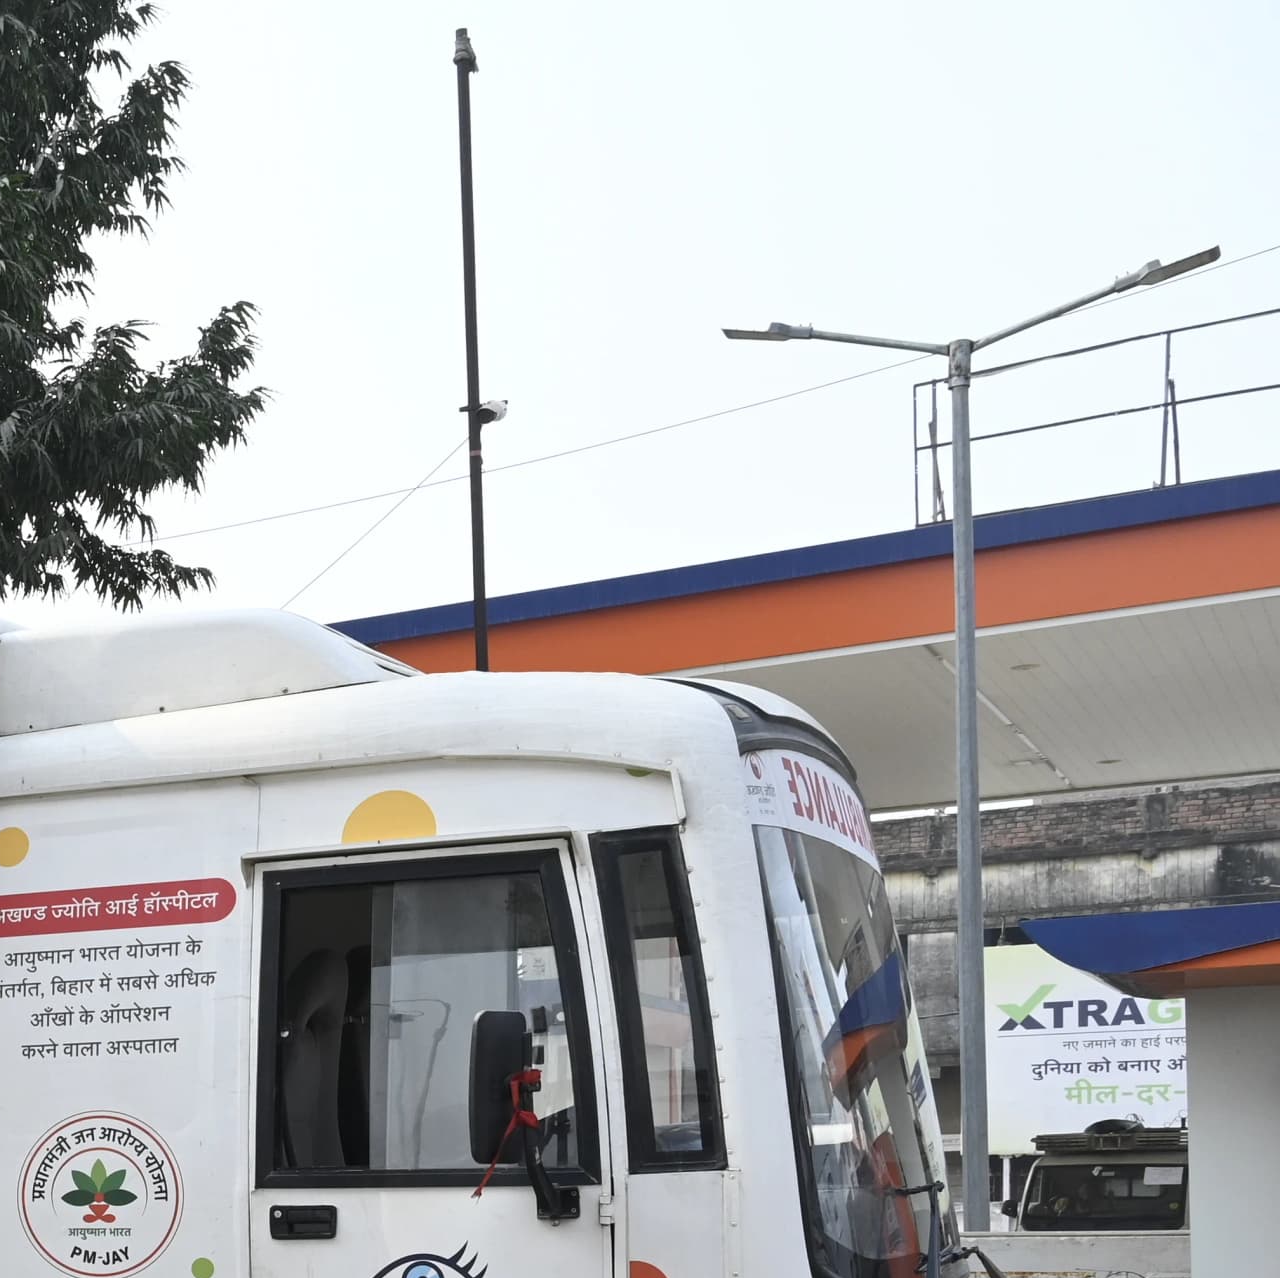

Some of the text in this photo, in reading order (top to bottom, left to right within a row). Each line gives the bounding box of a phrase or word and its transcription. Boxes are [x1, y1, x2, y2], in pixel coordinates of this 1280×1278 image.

[51, 897, 101, 919] ज्योति
[105, 893, 139, 917] आई
[143, 889, 220, 914] हॉस्पीटल
[4, 935, 203, 973] आयुष्मान भारत योजना के
[51, 975, 95, 996] बिहार
[99, 972, 114, 993] में
[117, 969, 159, 992] सबसे
[164, 967, 217, 988] अधिक
[30, 1002, 172, 1028] आँखों के ऑपरेशन
[21, 1037, 180, 1060] करने वाला अस्पताल
[1062, 1040, 1079, 1051] नए
[1082, 1036, 1116, 1049] जमाने
[1120, 1038, 1137, 1048] का
[1140, 1034, 1160, 1049] हाई
[1031, 1058, 1082, 1081] दुनिया
[1087, 1056, 1112, 1073] को
[1117, 1059, 1161, 1073] बनाए
[32, 1127, 168, 1202] प्रधानमंत्री जन आरोग्य योजना
[68, 1227, 132, 1240] आयुष्मान भारत
[70, 1246, 130, 1266] PM-JAY
